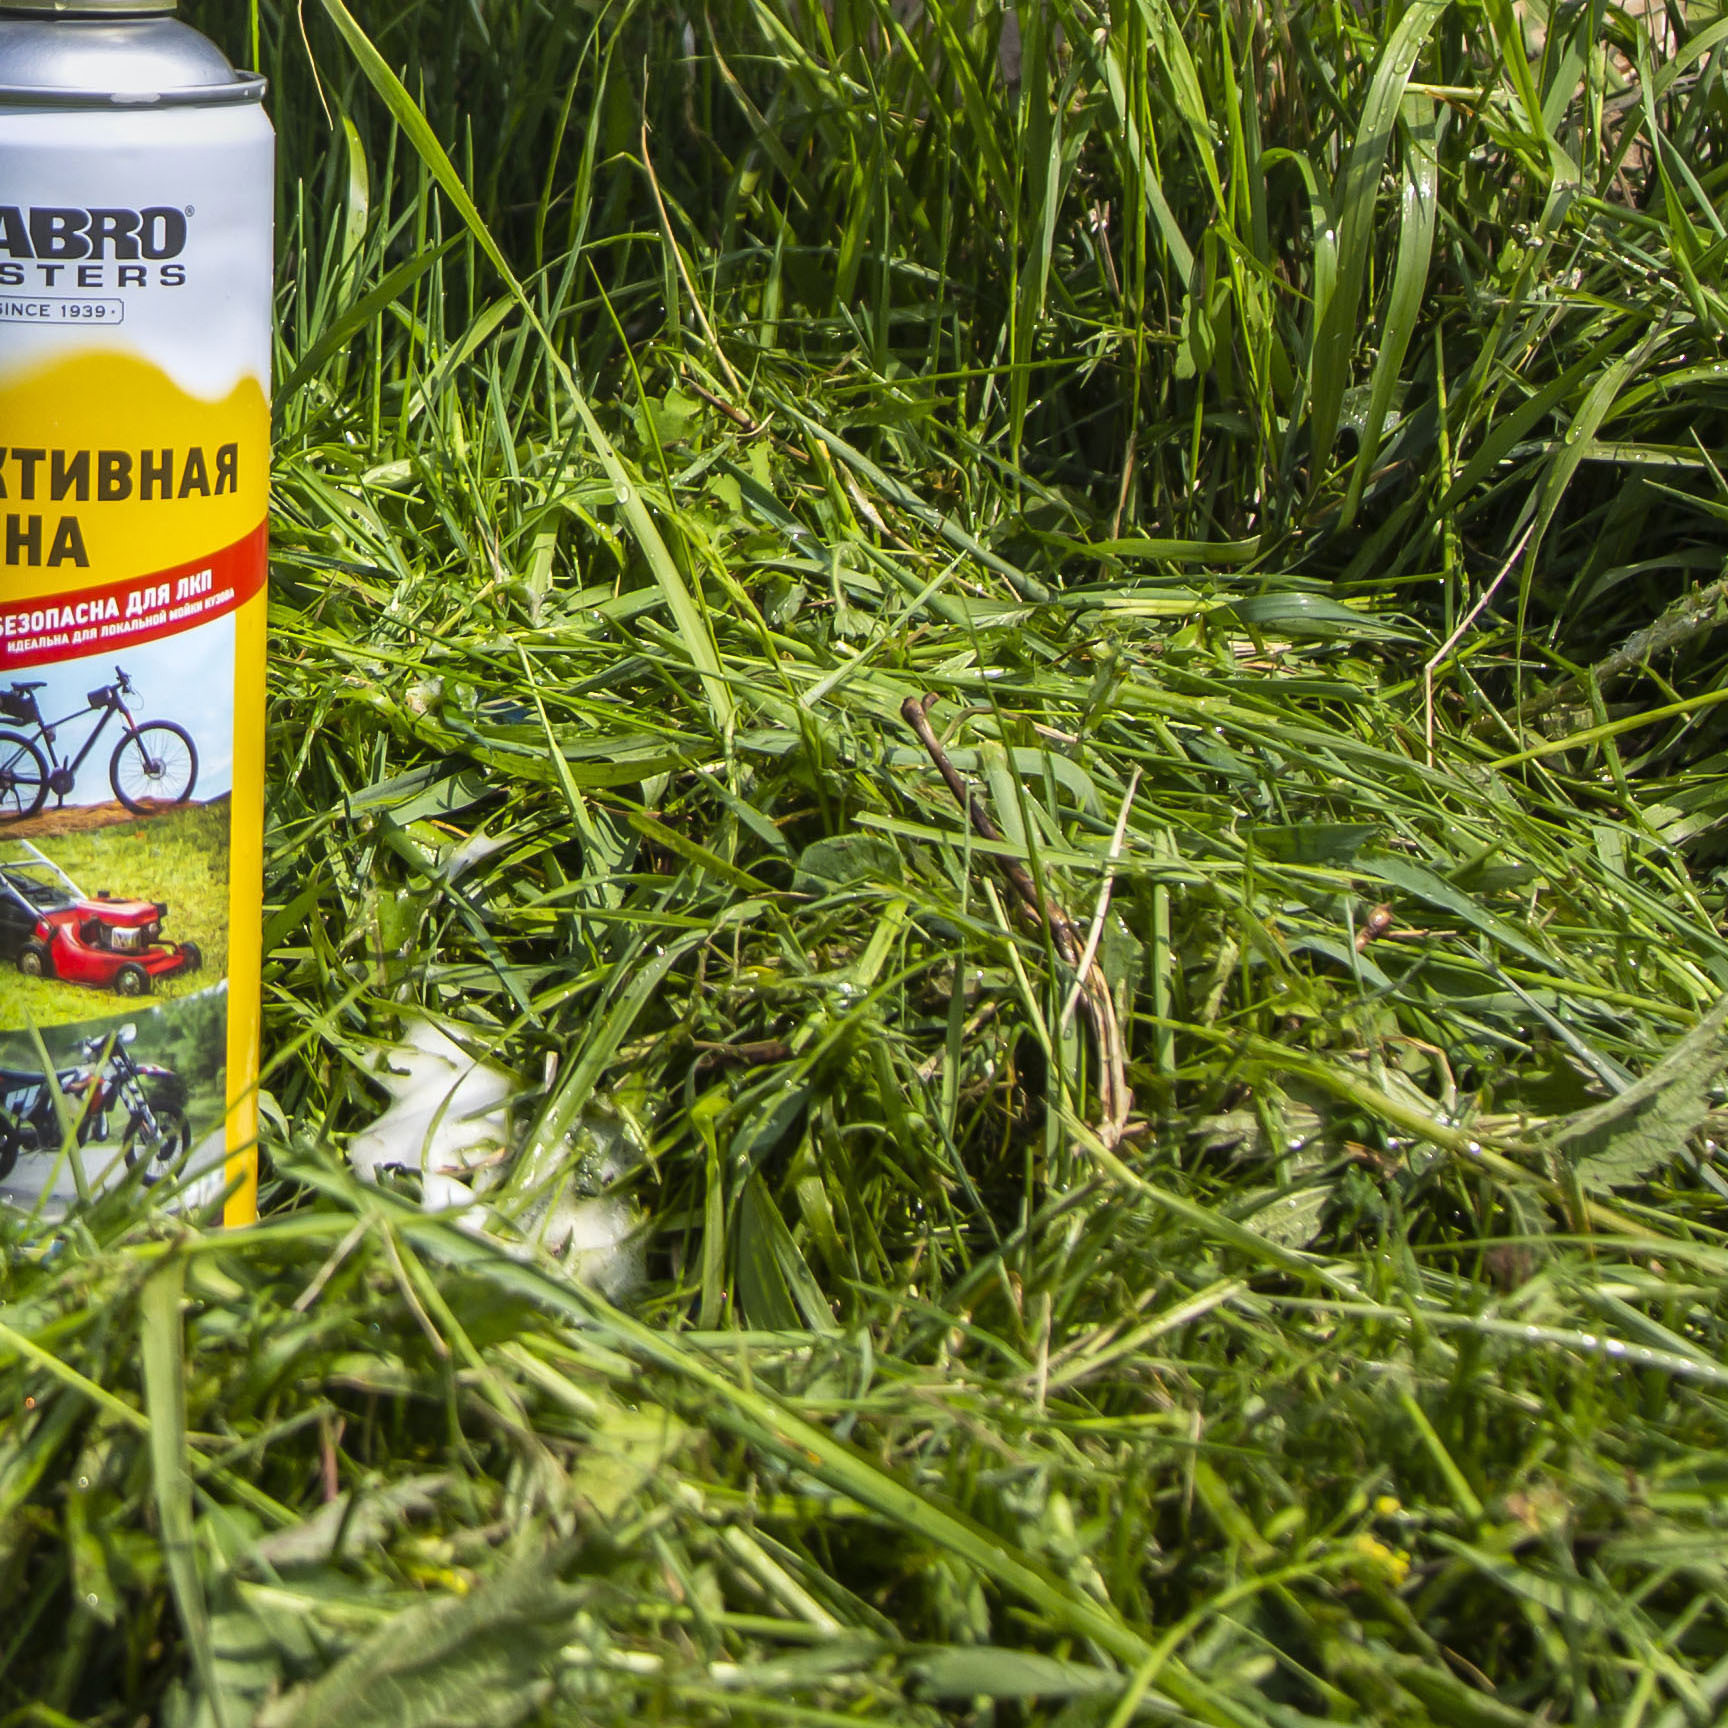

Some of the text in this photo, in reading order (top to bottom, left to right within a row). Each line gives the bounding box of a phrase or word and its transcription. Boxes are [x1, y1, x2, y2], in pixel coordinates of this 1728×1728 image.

[60, 304, 106, 318] 1939
[125, 583, 170, 618] ДЛЯ
[176, 569, 212, 601] ЛКП
[7, 634, 69, 653] ИДЕАЛЬНА
[72, 628, 98, 644] ДЛЯ
[100, 610, 167, 638] ЛОКАЛЬНОЙ
[169, 600, 203, 621] МОЙКИ
